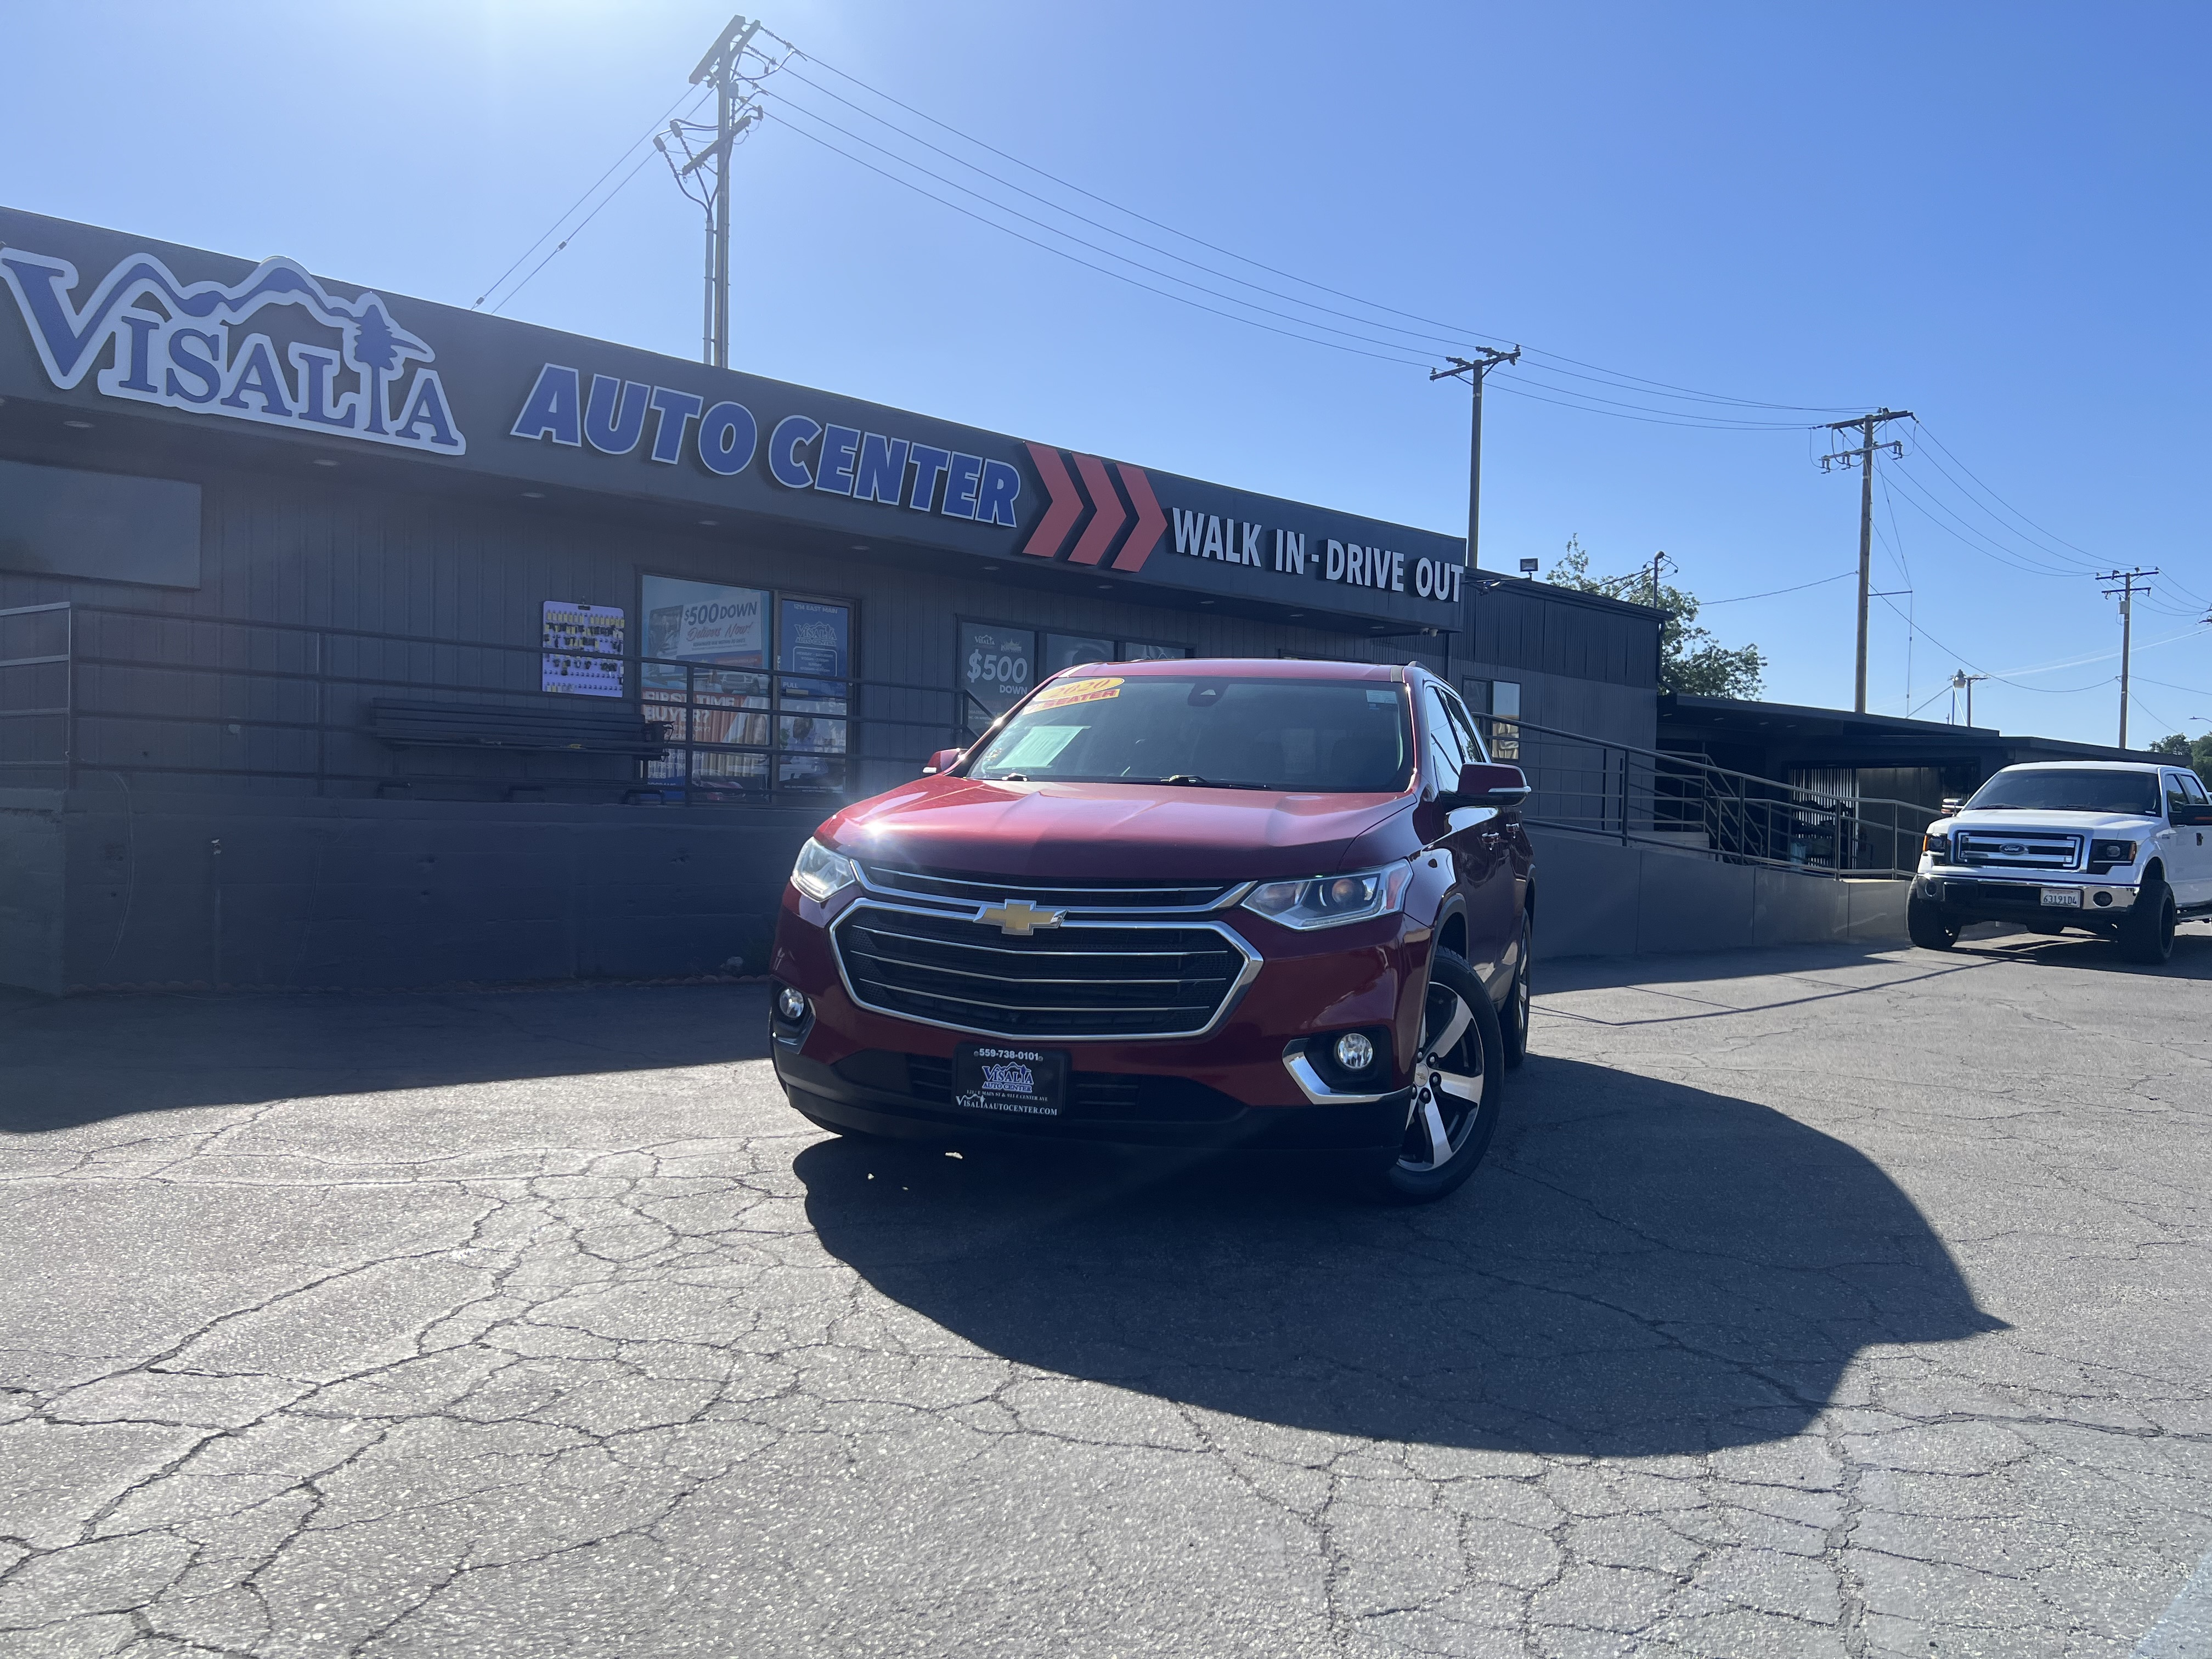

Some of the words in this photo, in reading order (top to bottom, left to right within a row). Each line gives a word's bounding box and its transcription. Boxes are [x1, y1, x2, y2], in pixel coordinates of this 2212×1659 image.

[0, 247, 466, 455] VISALIA
[510, 363, 758, 475] AUTO
[768, 415, 1021, 528] CENTER
[1172, 506, 1262, 568] WALK
[1325, 539, 1404, 592] DRIVE
[1415, 557, 1464, 603] OUT
[684, 603, 719, 626] $500
[720, 601, 758, 619] DOWN
[794, 622, 837, 641] VISALIA
[974, 634, 995, 645] VISALIA
[967, 649, 1028, 684] $500
[1000, 685, 1028, 695] DOWN
[1042, 689, 1117, 709] SEATER
[1047, 679, 1110, 698] 2020
[979, 1048, 1039, 1061] 559-738-0101
[981, 1061, 1034, 1085] VISALIA
[981, 1081, 1003, 1090] AUTO
[1003, 1083, 1032, 1093] CENTER
[956, 1093, 1057, 1116] VISALIAAUTOCENTER.COM
